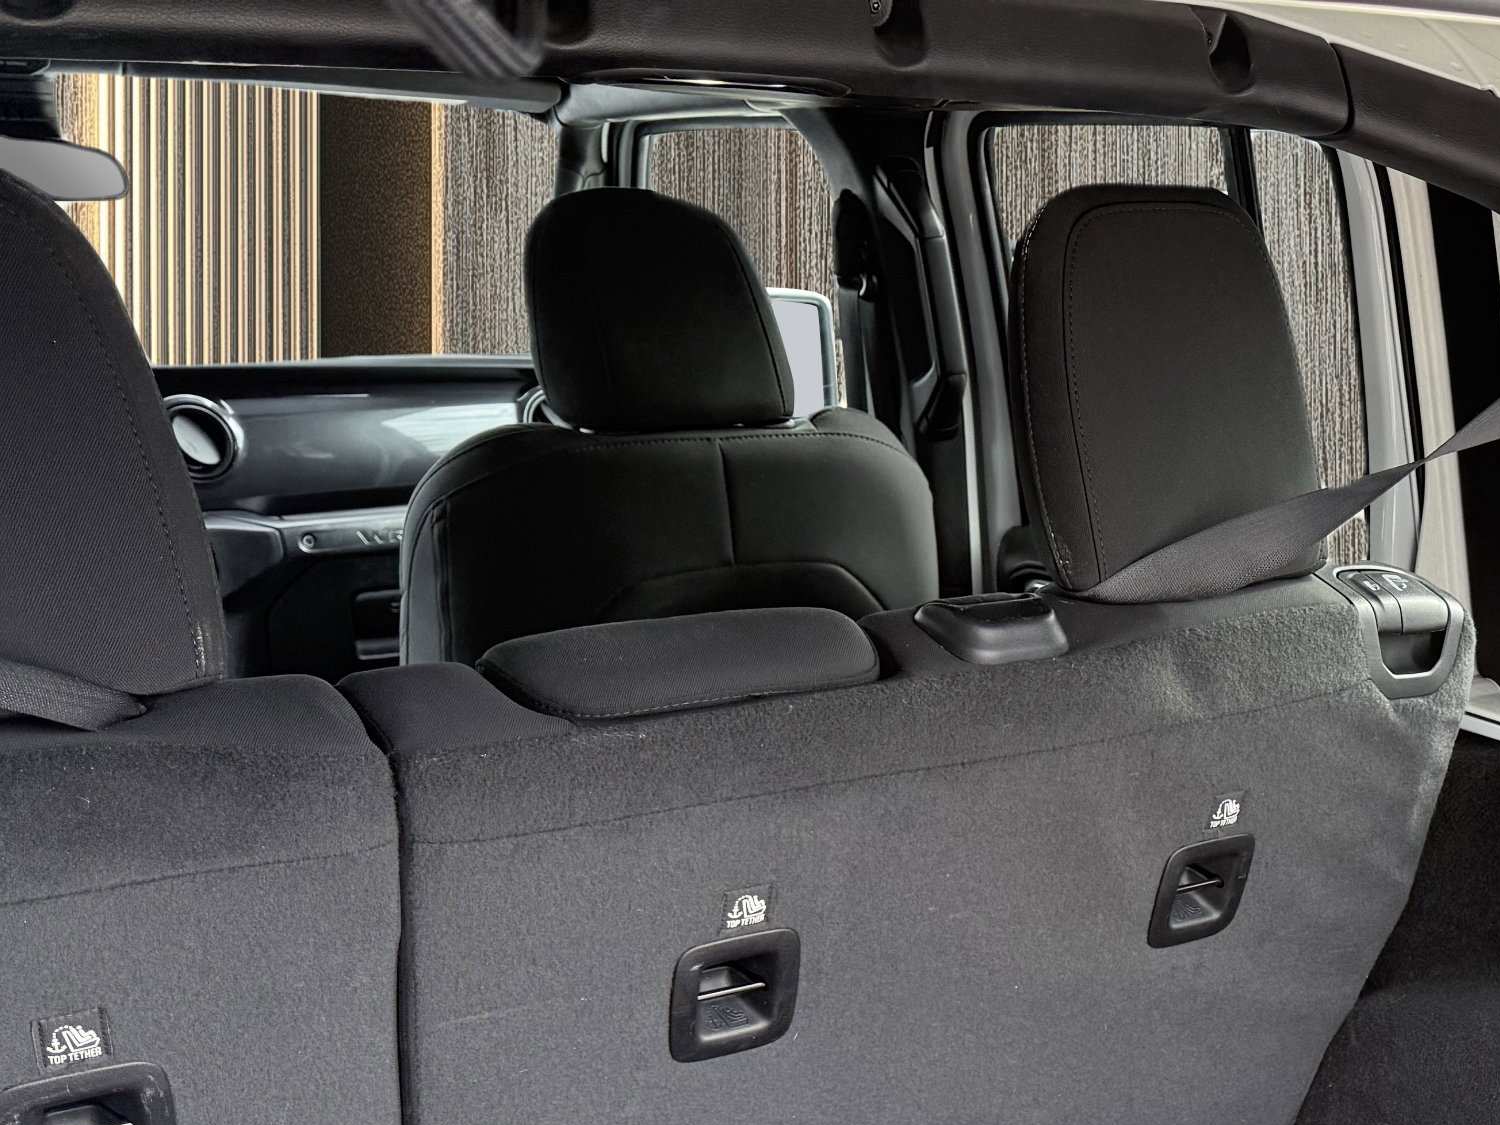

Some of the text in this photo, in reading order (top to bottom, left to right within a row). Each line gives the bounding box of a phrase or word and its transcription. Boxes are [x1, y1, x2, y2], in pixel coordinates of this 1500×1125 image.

[726, 915, 766, 929] TOP TETHER
[48, 1047, 102, 1066] TOP TETHER
